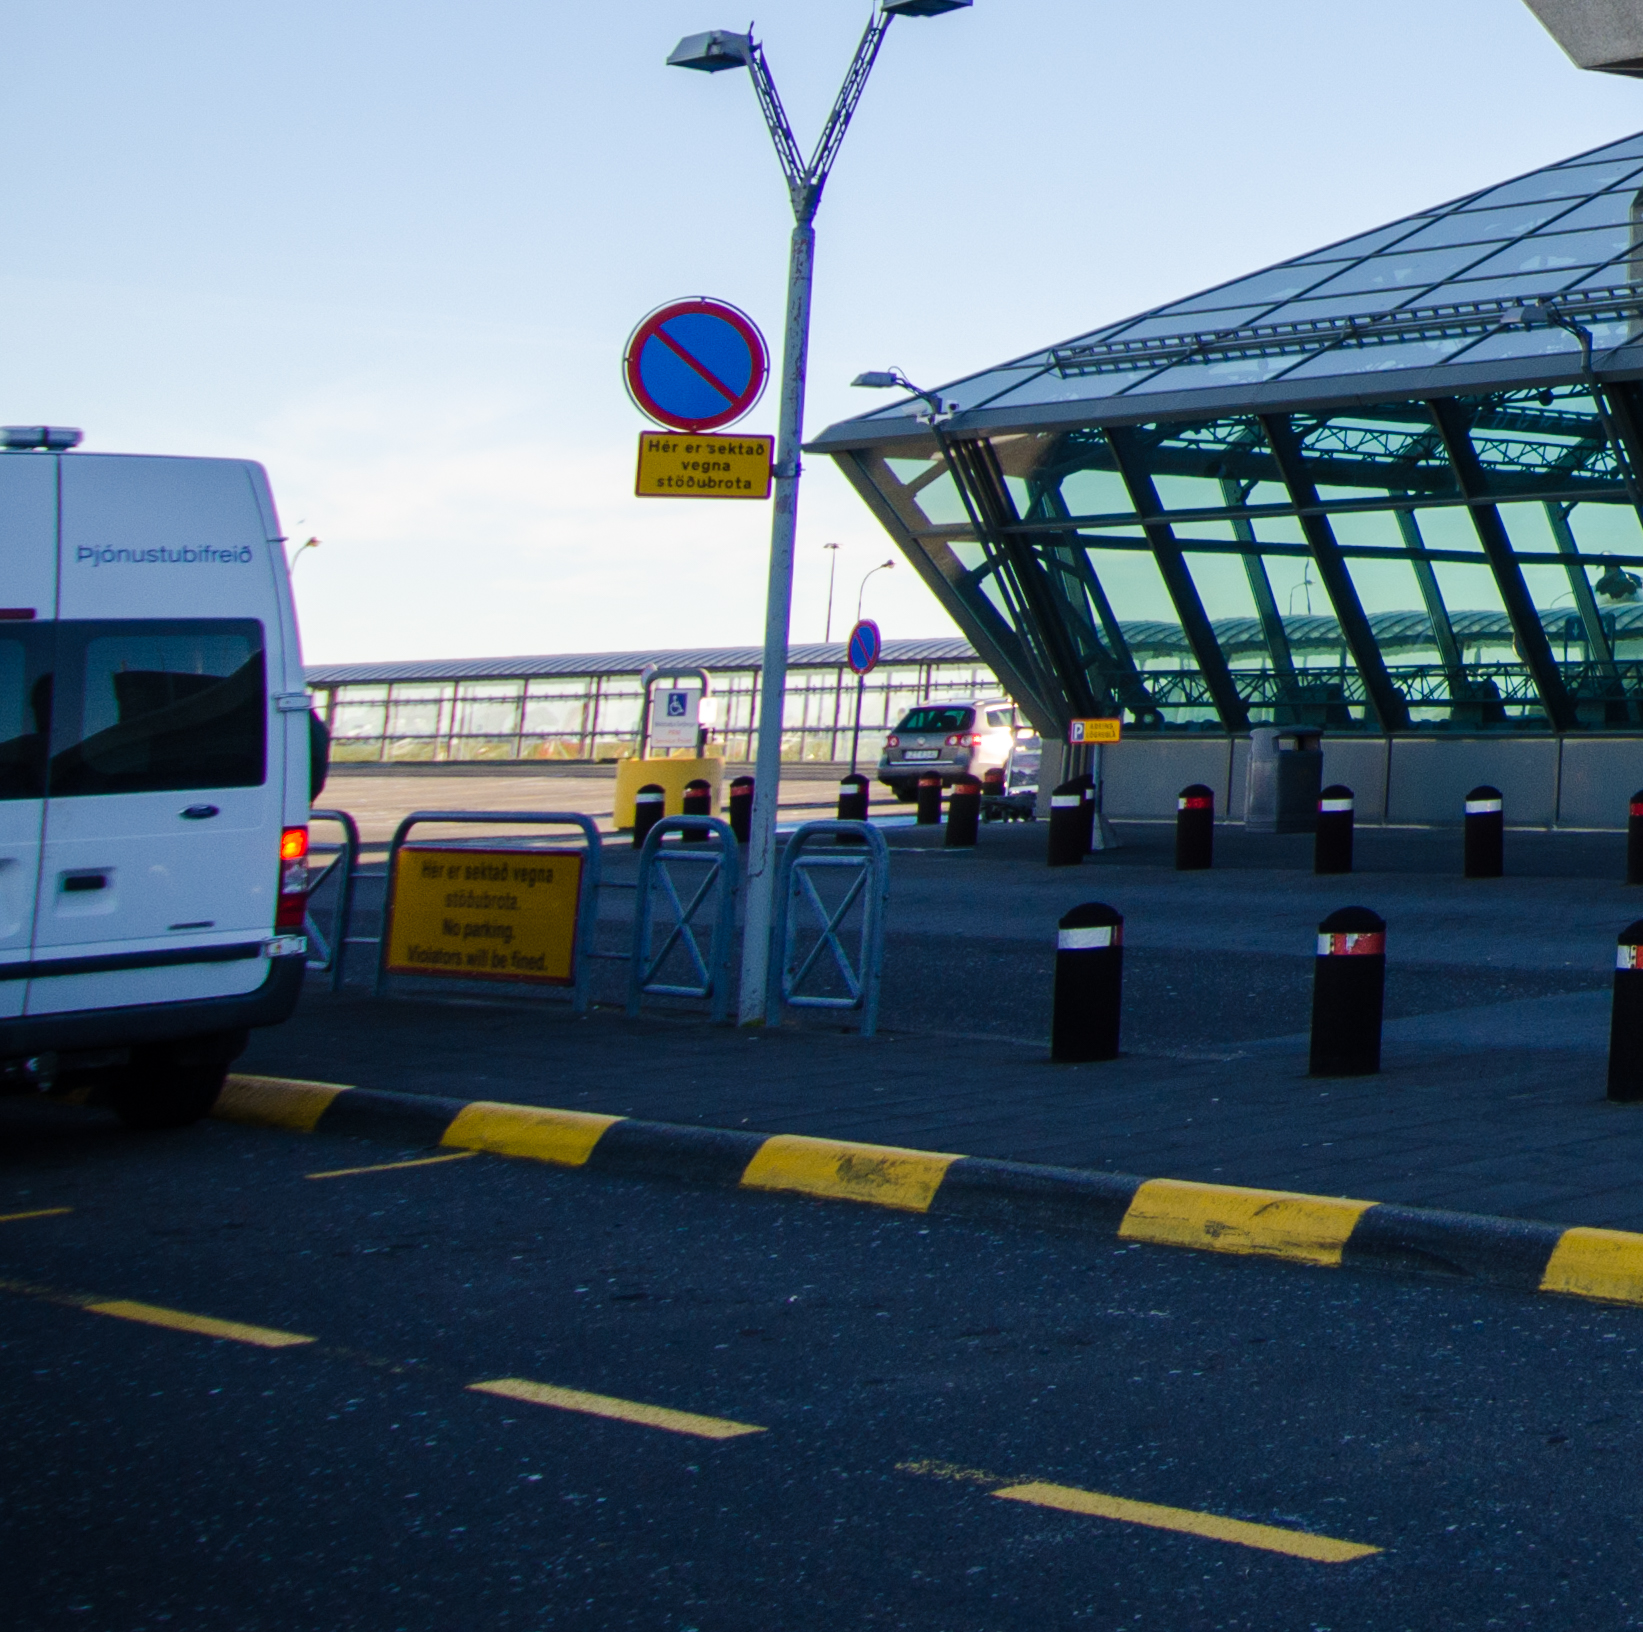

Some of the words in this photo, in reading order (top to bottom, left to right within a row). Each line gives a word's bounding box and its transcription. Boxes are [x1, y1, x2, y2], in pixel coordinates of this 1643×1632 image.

[647, 439, 678, 453] Hér
[685, 443, 701, 454] er
[707, 442, 765, 456] sektað
[682, 460, 731, 473] vegna
[656, 474, 752, 489] stöðubrota
[76, 544, 253, 567] Þjónustubifreið
[1073, 723, 1084, 740] P
[422, 860, 444, 879] Hér
[447, 866, 462, 880] er
[465, 862, 508, 881] sektað
[513, 868, 554, 888] vegna
[443, 918, 461, 936] No
[408, 945, 463, 966] Violators
[466, 949, 489, 966] will
[492, 950, 508, 968] be
